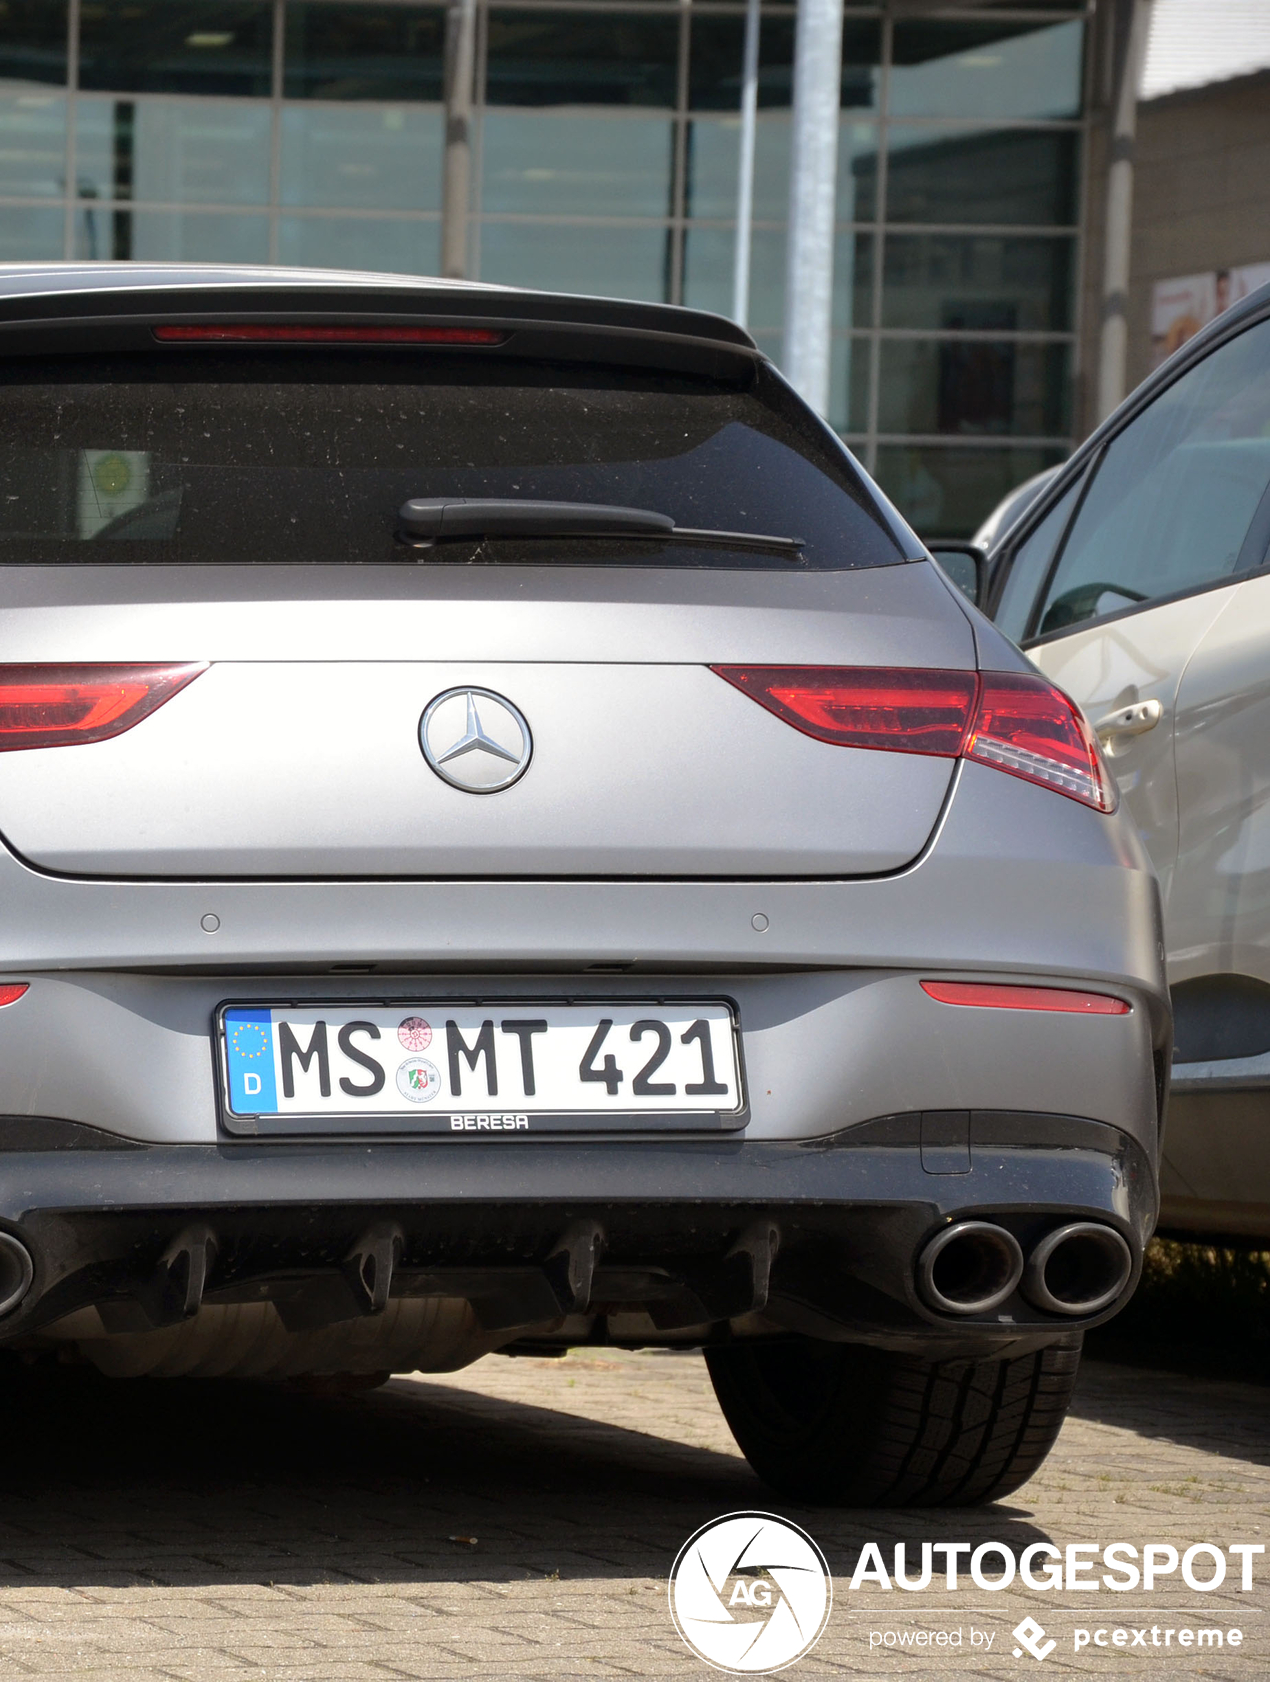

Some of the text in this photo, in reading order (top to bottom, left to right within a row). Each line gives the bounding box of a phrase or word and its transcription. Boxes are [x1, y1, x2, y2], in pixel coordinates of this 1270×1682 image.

[278, 1020, 386, 1098] MS
[446, 1019, 549, 1096] MT
[579, 1018, 728, 1096] 421
[243, 1072, 262, 1095] D
[450, 1115, 529, 1130] BERESA
